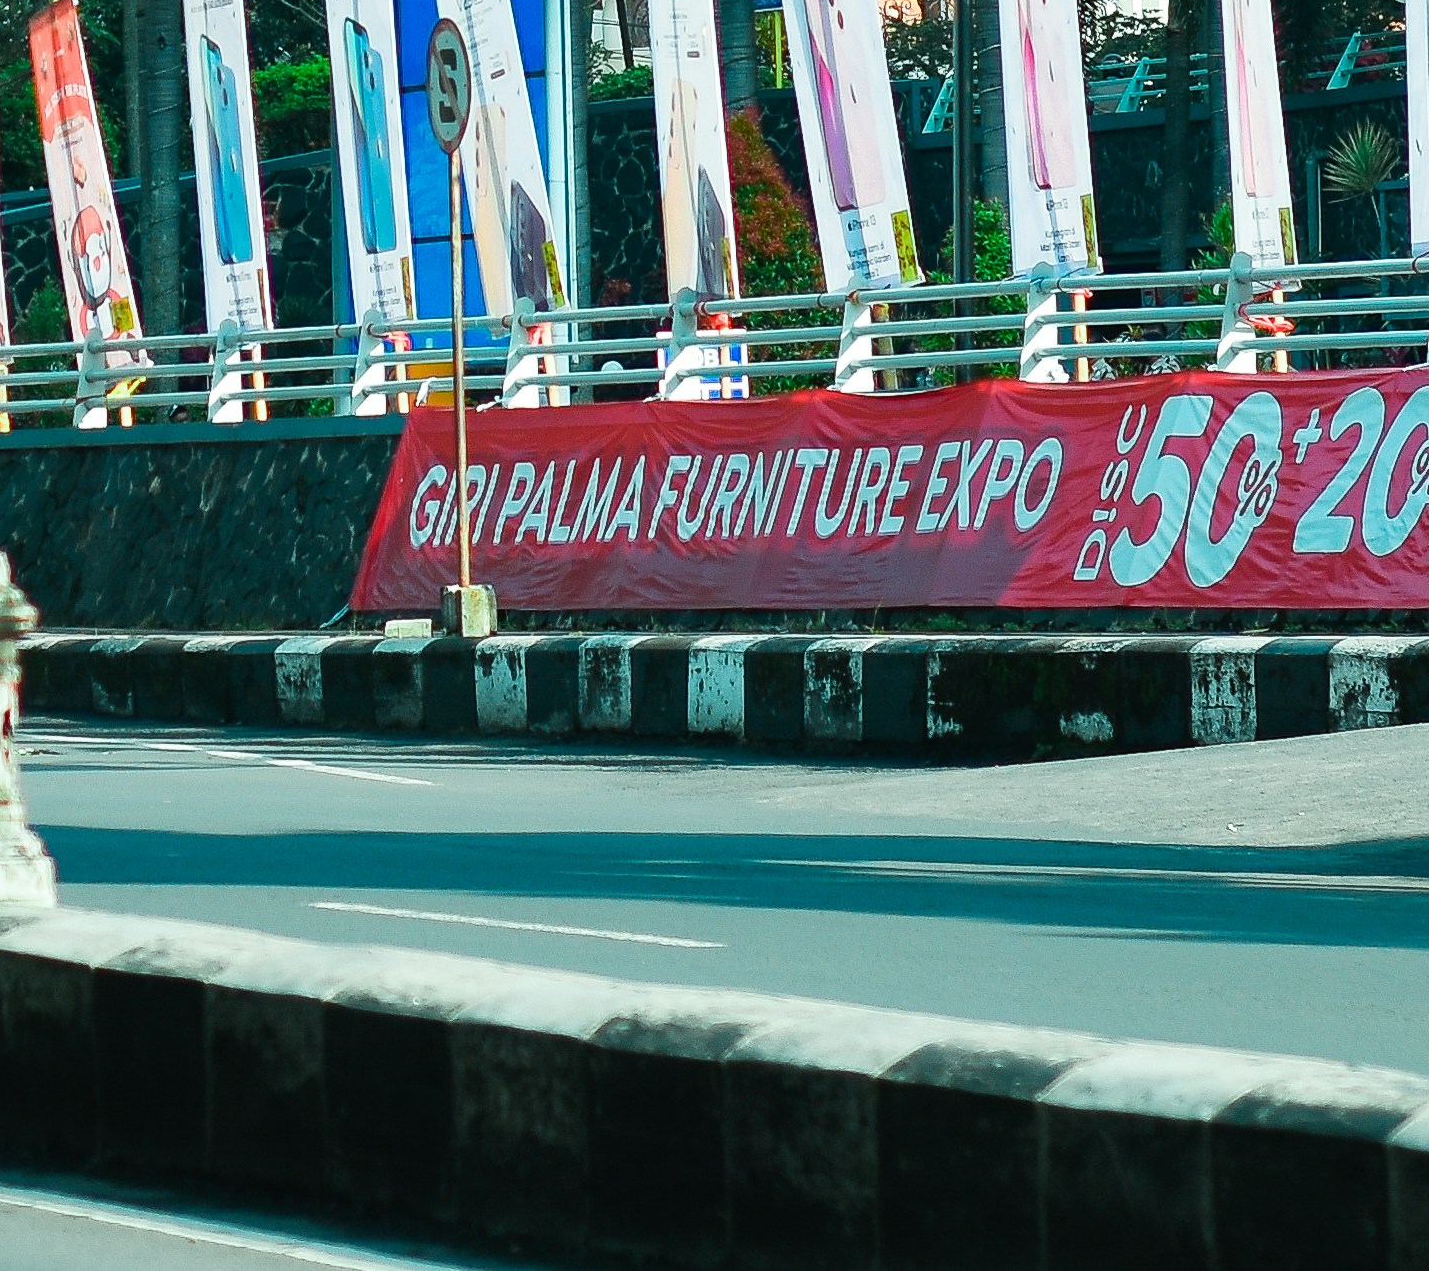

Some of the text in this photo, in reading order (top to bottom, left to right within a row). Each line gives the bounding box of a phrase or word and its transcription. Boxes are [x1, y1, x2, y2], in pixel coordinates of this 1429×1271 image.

[409, 437, 1064, 550] GIRI PALMA FURNITURE EXPO
